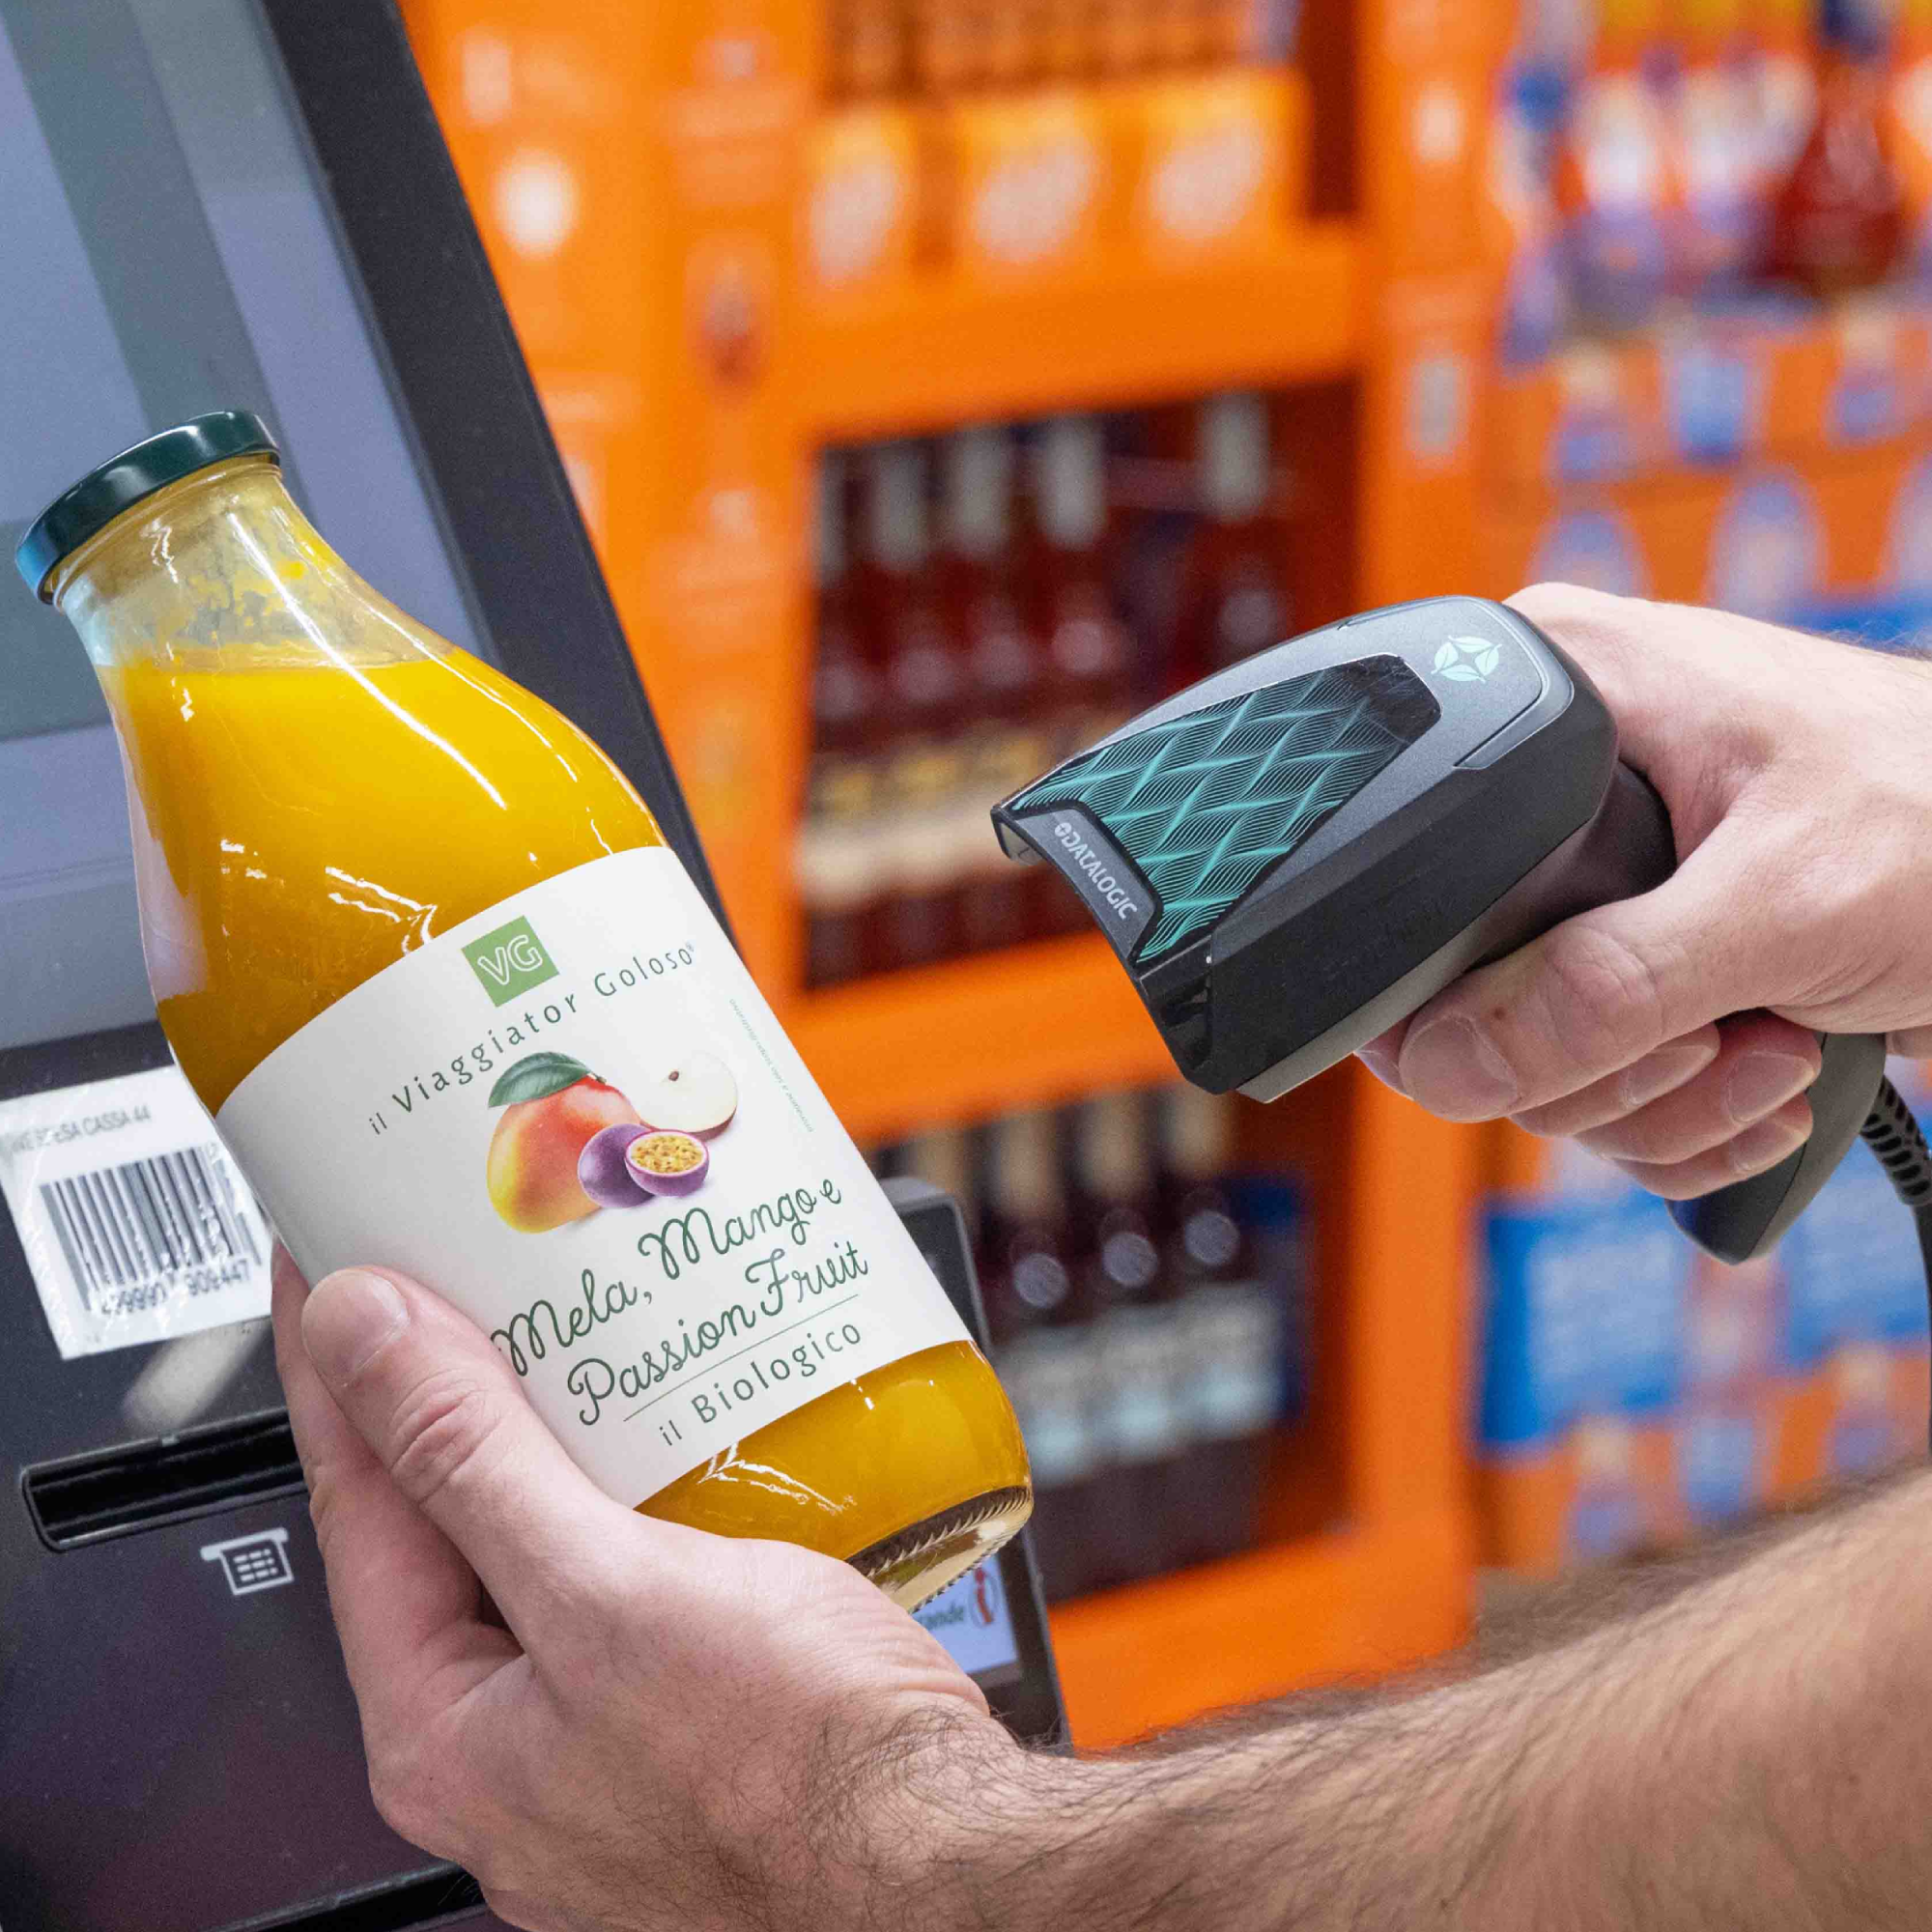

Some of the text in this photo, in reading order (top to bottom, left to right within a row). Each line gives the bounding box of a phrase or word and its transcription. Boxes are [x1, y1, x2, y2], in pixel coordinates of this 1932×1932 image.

[1061, 831, 1138, 921] DATALOGIC
[476, 934, 544, 986] VG
[82, 1110, 131, 1136] CASSA
[368, 1111, 388, 1136] il
[391, 991, 578, 1114] Viaggiator
[490, 1178, 842, 1378] Mela, Mango e
[566, 1239, 869, 1427] Passion Fruit
[658, 1322, 862, 1447] il Biologico
